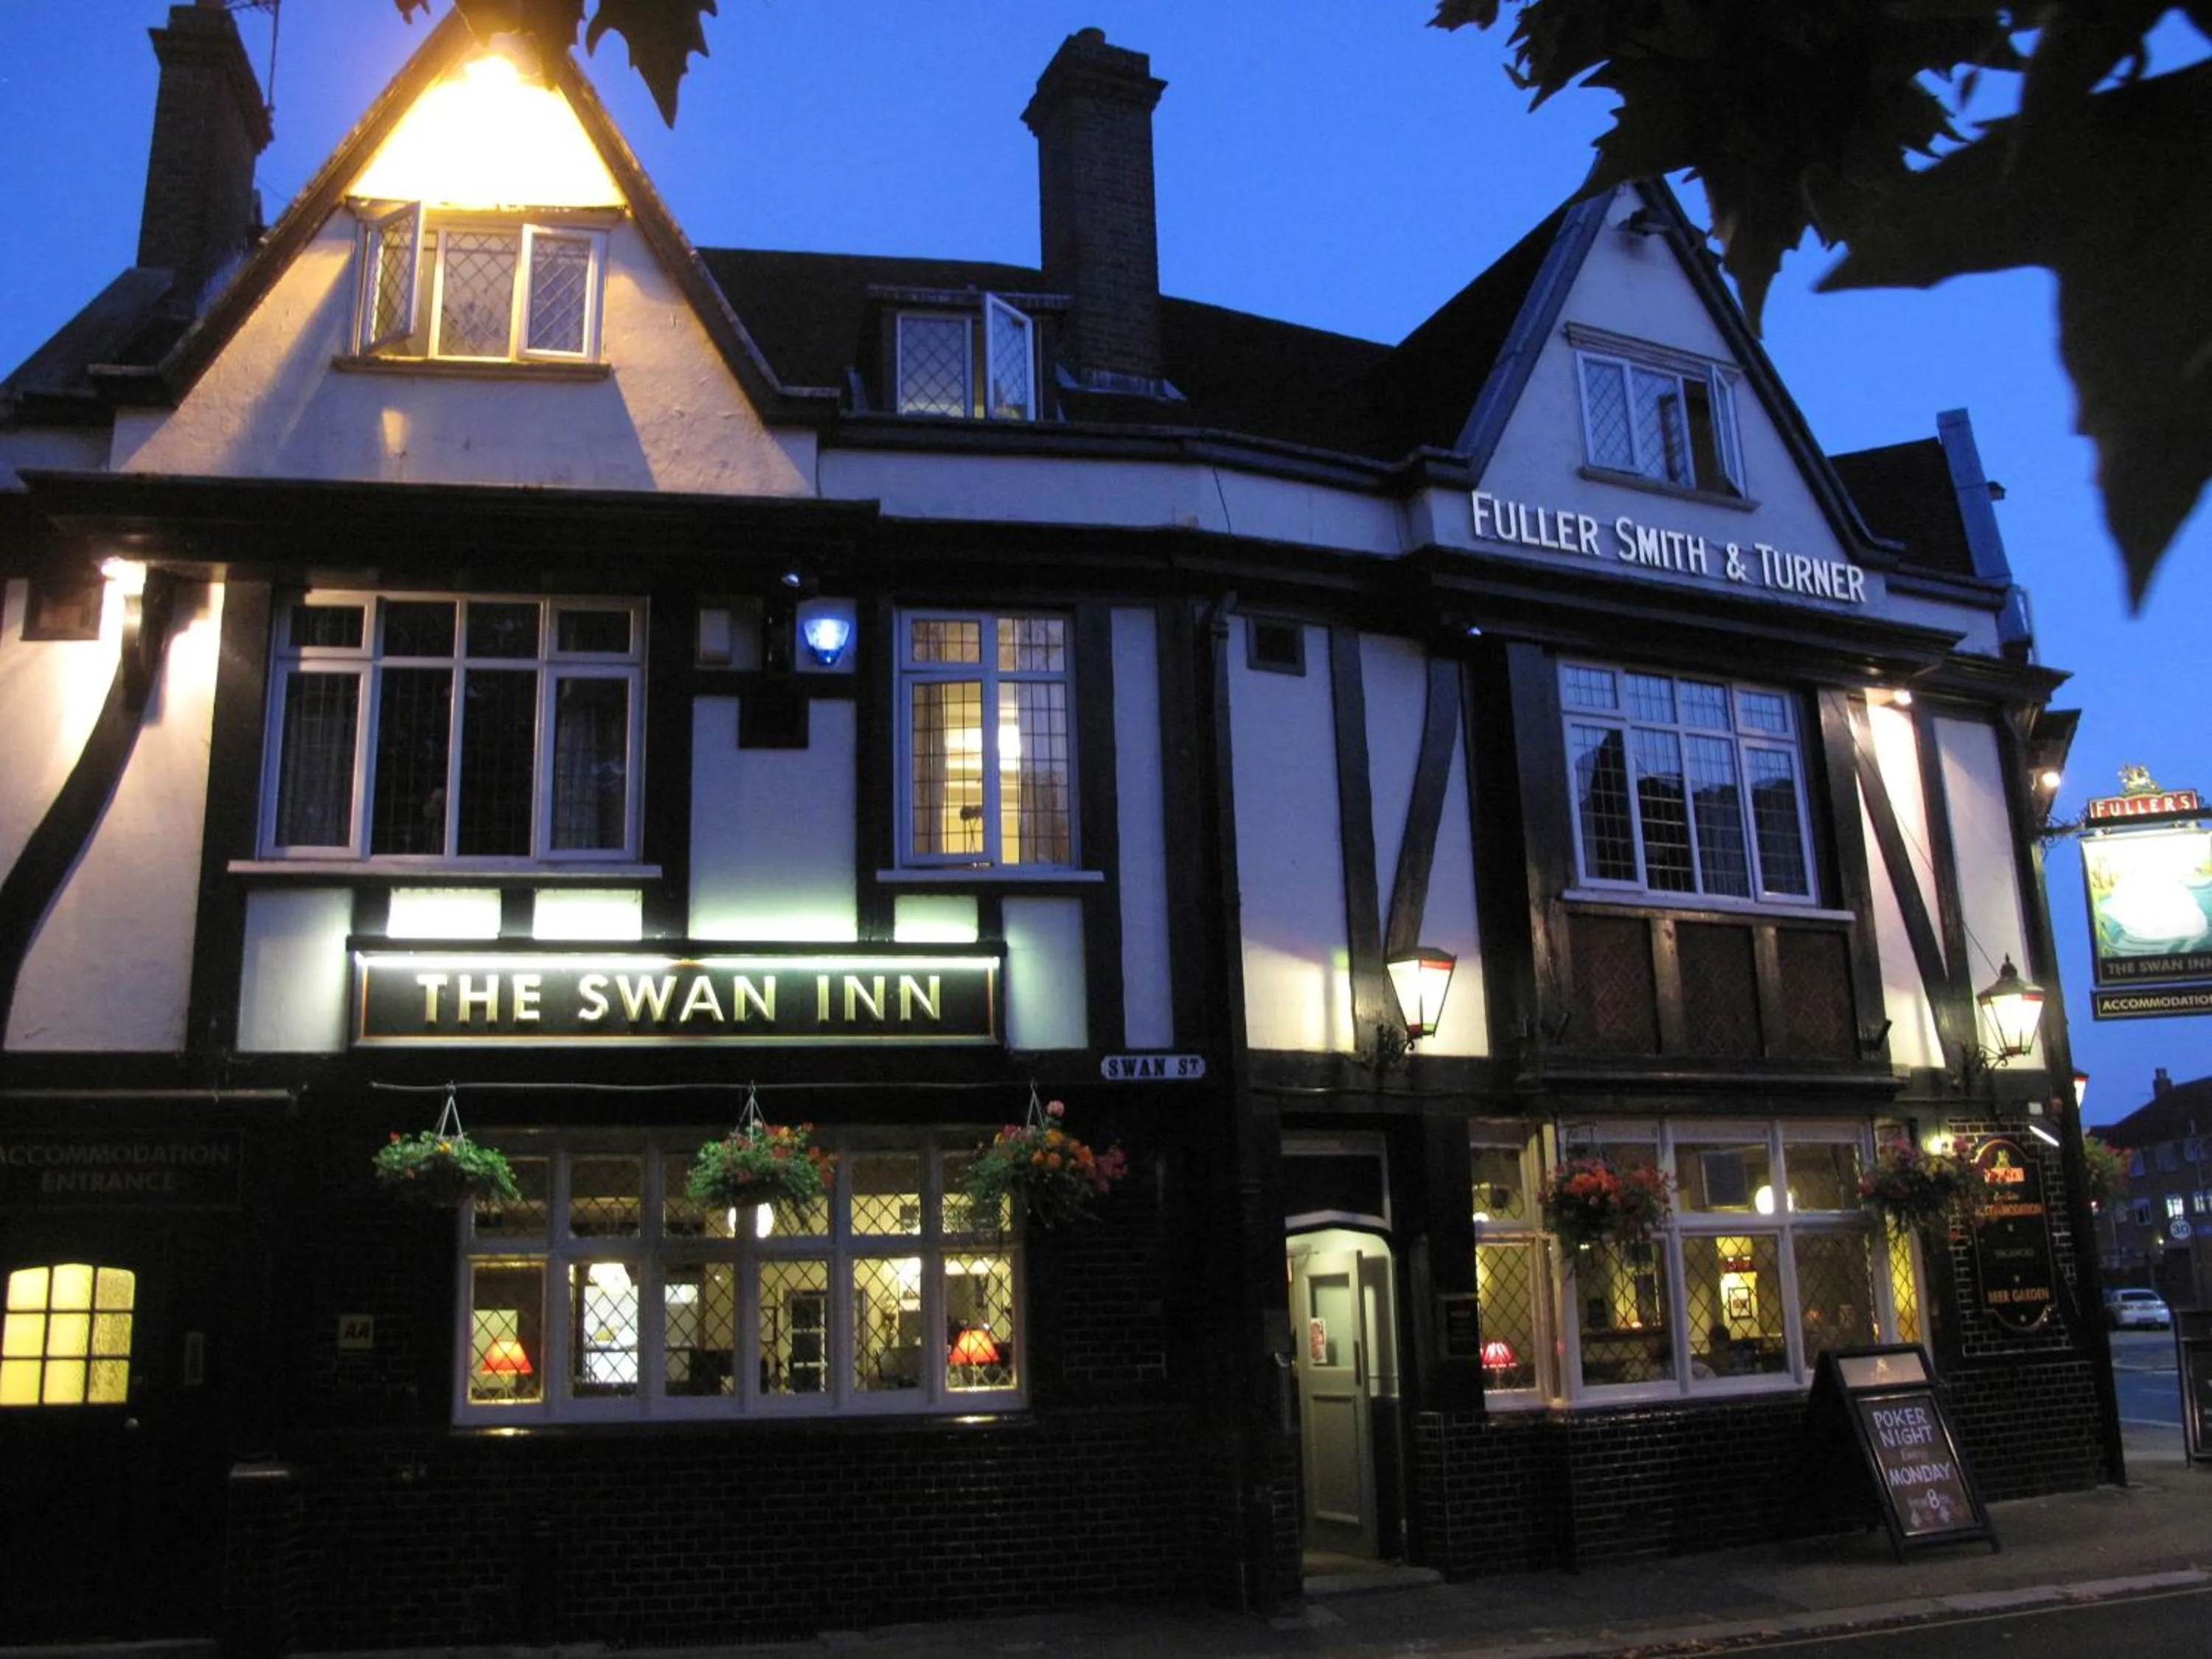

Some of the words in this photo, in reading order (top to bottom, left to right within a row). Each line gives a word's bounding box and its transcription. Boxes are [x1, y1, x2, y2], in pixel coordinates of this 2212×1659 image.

[1471, 491, 1600, 555] FULLER
[1615, 517, 1708, 574] SMITH
[1725, 543, 1747, 582] &
[1754, 543, 1866, 602] TURNER
[2107, 961, 2135, 975] THE
[2138, 959, 2183, 973] SWAN
[417, 975, 541, 1023] THE
[577, 974, 776, 1023] SWAN
[817, 975, 942, 1023] INN
[2102, 994, 2212, 1011] ACCOMMODATIO
[1108, 1058, 1166, 1078] SWAN
[1178, 1058, 1200, 1075] ST
[41, 1170, 177, 1194] ENTRANCE
[2175, 1225, 2189, 1235] 30
[2012, 1287, 2049, 1302] GARDEN
[344, 1321, 370, 1339] AA
[1872, 1408, 1927, 1428] POKER
[1879, 1425, 1933, 1447] NIGHT
[1889, 1460, 1950, 1486] MONDAY
[1927, 1488, 1939, 1509] 8
